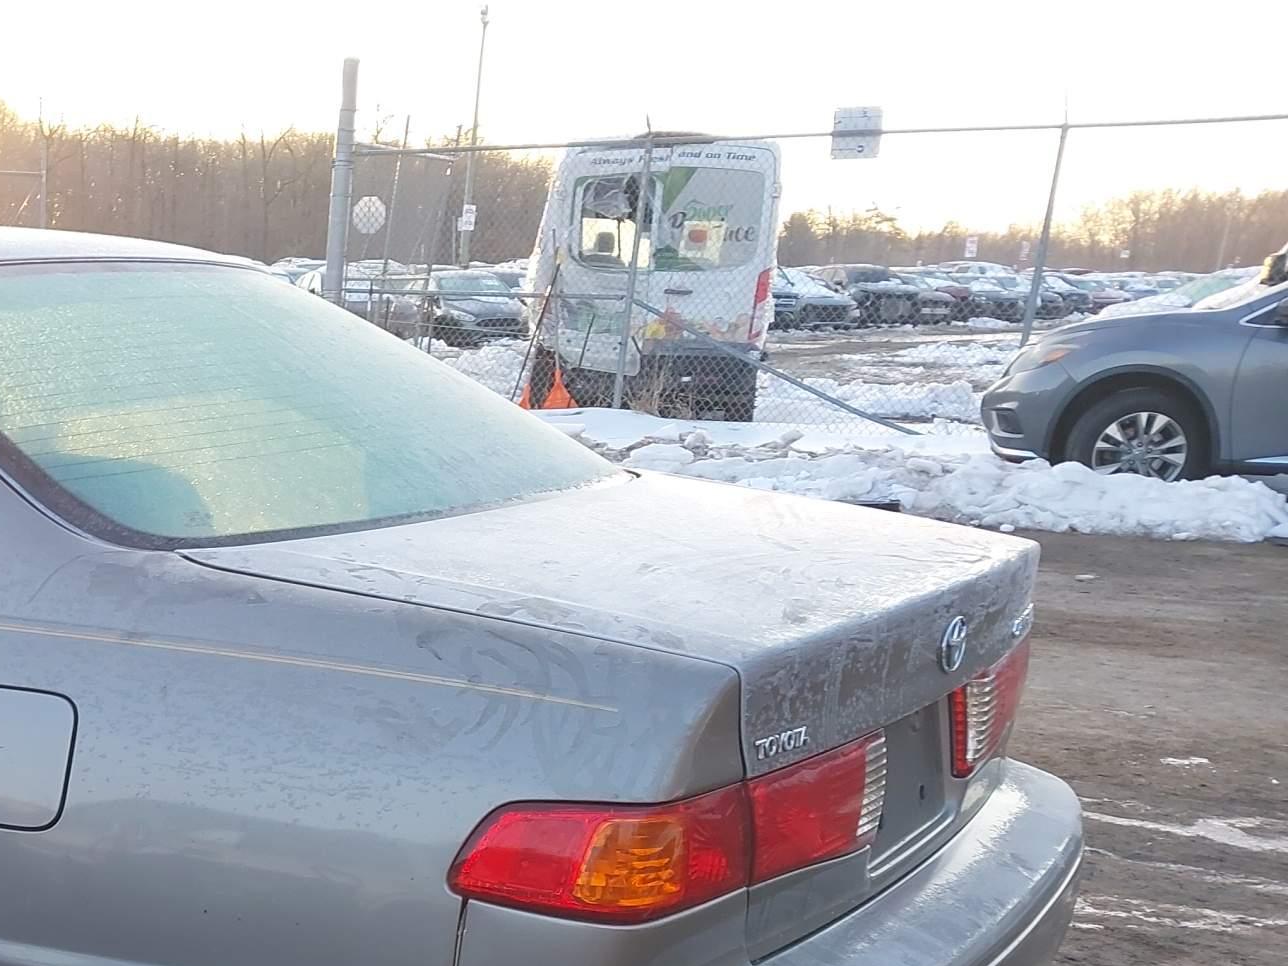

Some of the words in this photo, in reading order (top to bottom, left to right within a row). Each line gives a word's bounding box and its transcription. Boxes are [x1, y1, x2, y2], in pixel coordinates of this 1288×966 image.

[591, 158, 633, 166] Always
[678, 151, 702, 159] and
[725, 151, 756, 161] Time
[754, 725, 810, 760] TOYOTA
